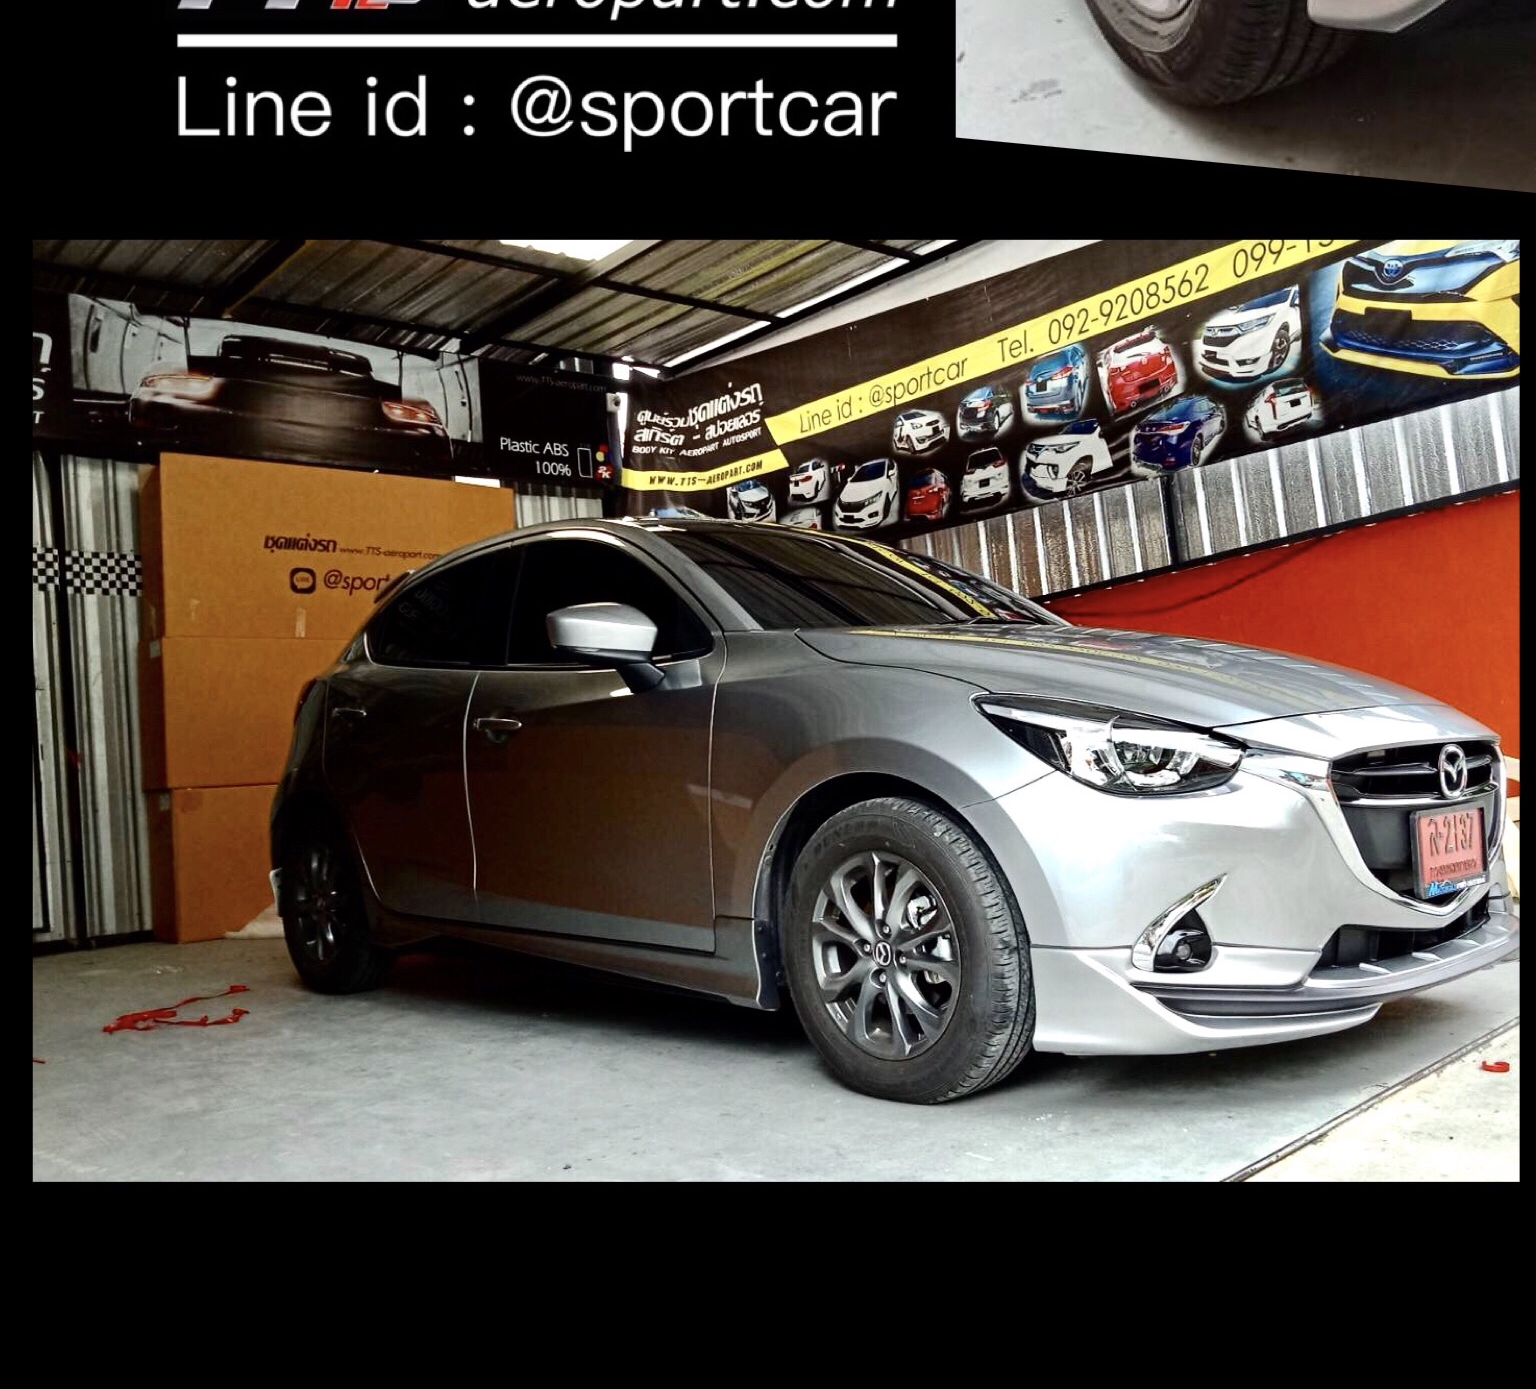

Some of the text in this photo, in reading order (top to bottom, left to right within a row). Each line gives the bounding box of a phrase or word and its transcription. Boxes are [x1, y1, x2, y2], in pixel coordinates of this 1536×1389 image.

[798, 402, 832, 436] Line
[833, 395, 854, 422] id
[868, 355, 968, 409] @sportcar
[997, 335, 1035, 364] Tel.
[1047, 263, 1209, 346] 092-9208562
[500, 436, 570, 457] Plastic ABS
[632, 427, 762, 457] BODY KIT AEROPART AUTOSPORT
[536, 461, 572, 477] 100%
